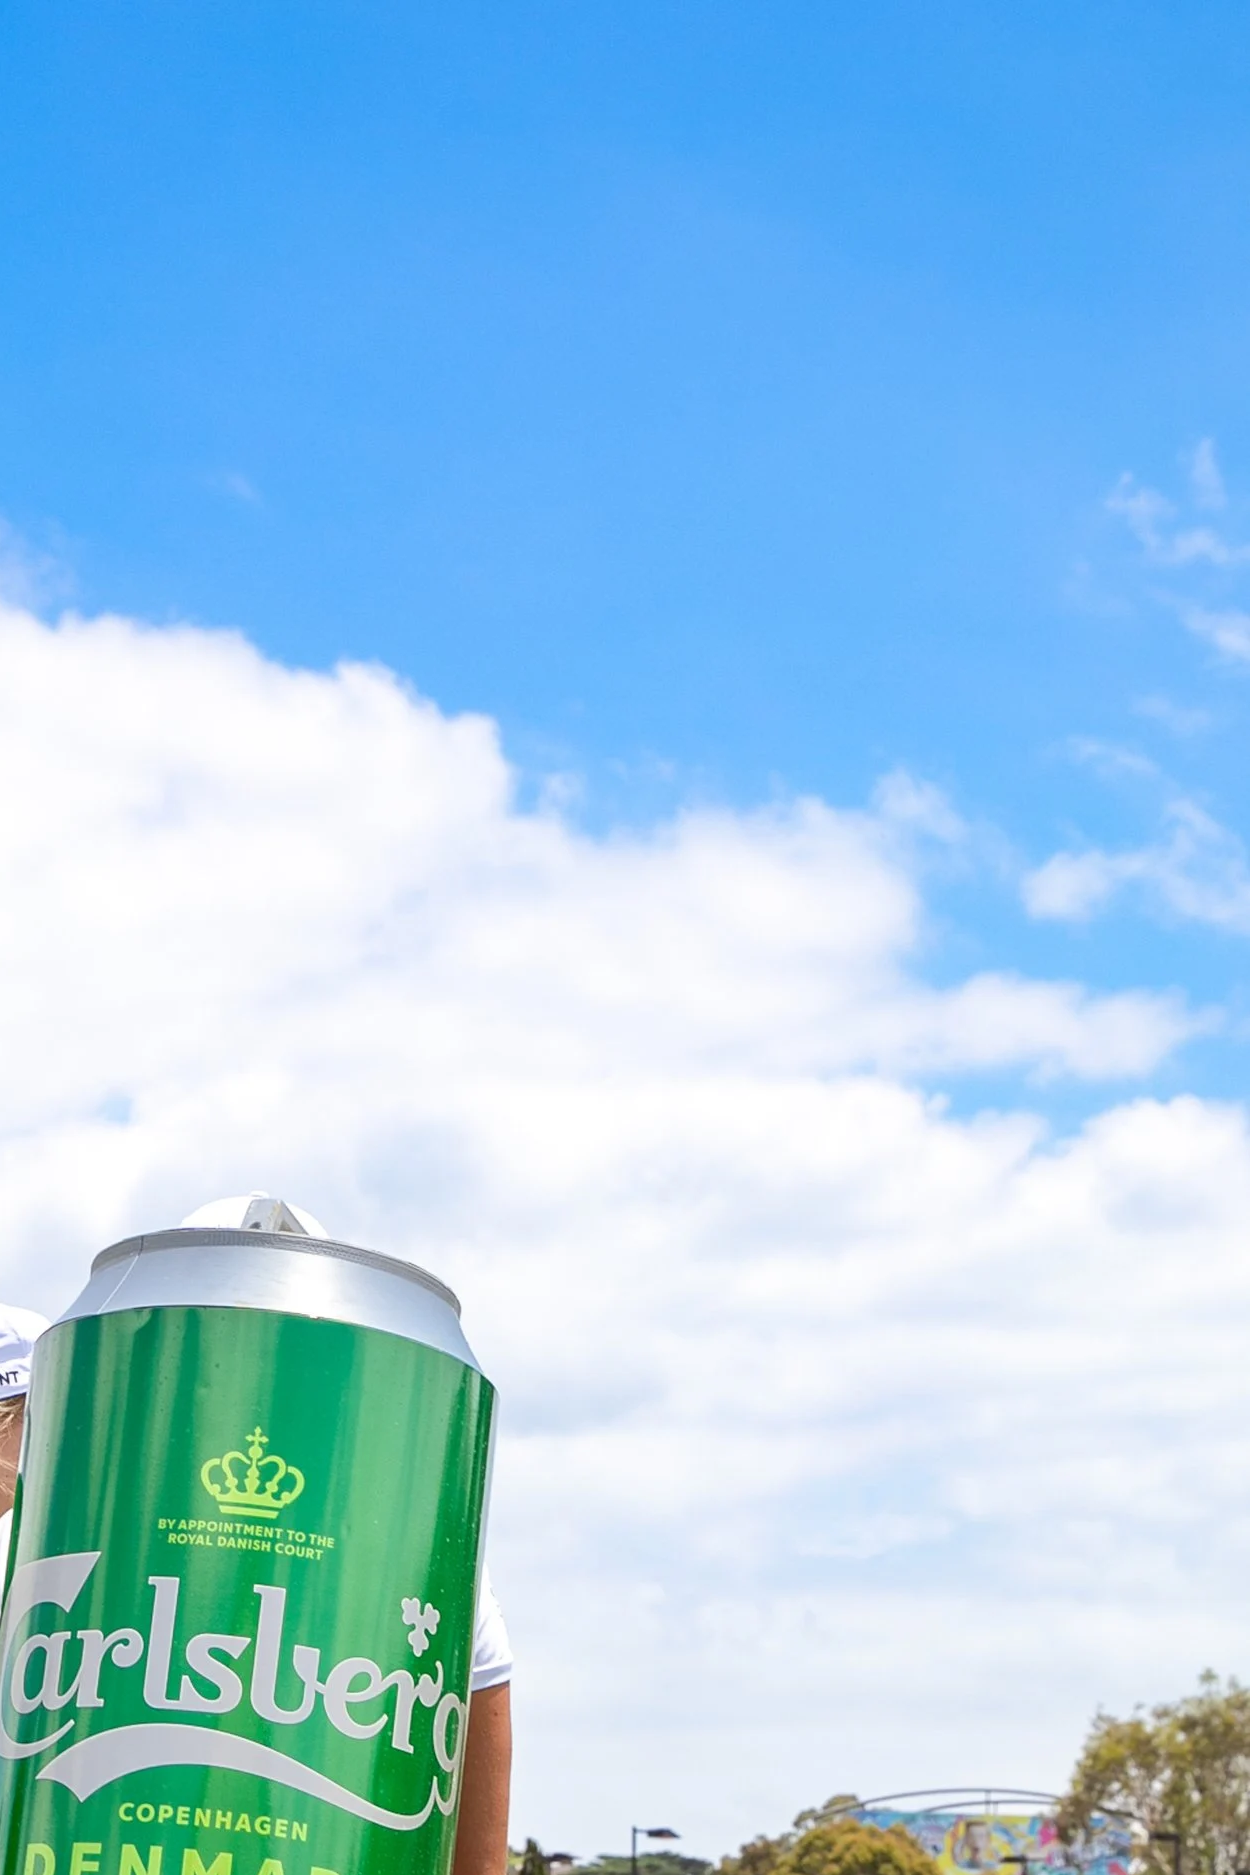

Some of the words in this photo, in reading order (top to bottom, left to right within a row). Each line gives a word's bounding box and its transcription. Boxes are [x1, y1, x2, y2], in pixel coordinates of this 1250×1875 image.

[158, 1518, 176, 1530] BY
[178, 1519, 284, 1539] APPOINTMENT
[287, 1530, 306, 1543] TO
[309, 1533, 335, 1549] THE
[168, 1533, 213, 1546] ROYAL
[217, 1536, 271, 1552] DANISH
[275, 1543, 324, 1561] COURT
[118, 1802, 309, 1842] COPENHAGEN
